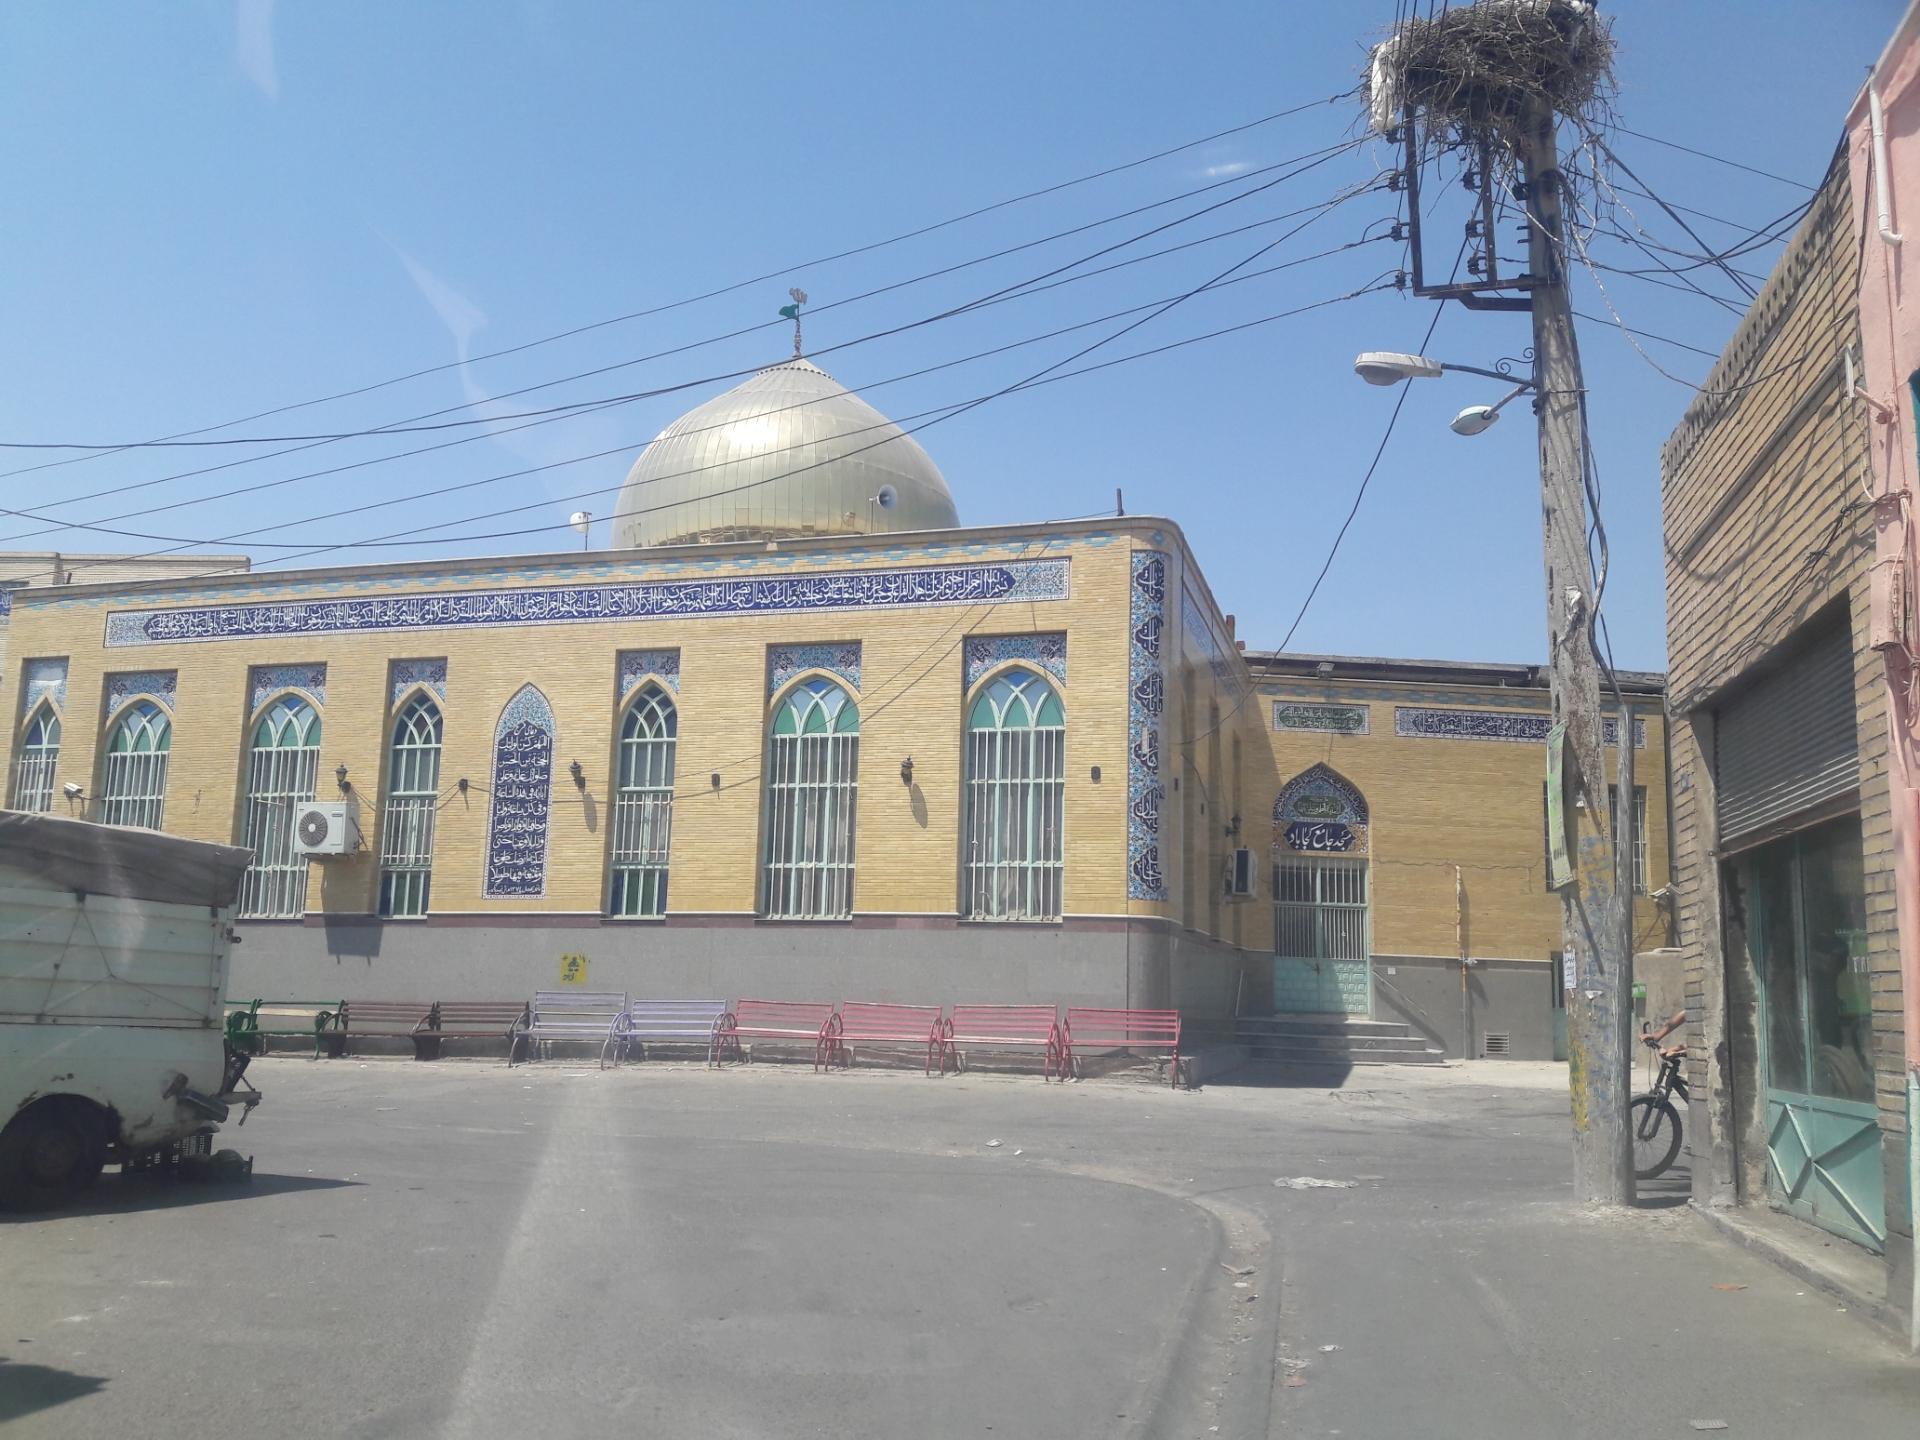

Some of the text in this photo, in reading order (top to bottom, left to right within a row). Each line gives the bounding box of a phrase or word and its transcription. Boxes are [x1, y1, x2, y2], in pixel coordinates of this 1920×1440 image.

[514, 722, 527, 736] فرج
[517, 735, 535, 751] کن
[498, 753, 521, 767] الحسن
[521, 754, 532, 767] بن
[524, 801, 537, 816] کل
[1312, 828, 1334, 850] جامع
[1332, 829, 1351, 850] مسجد
